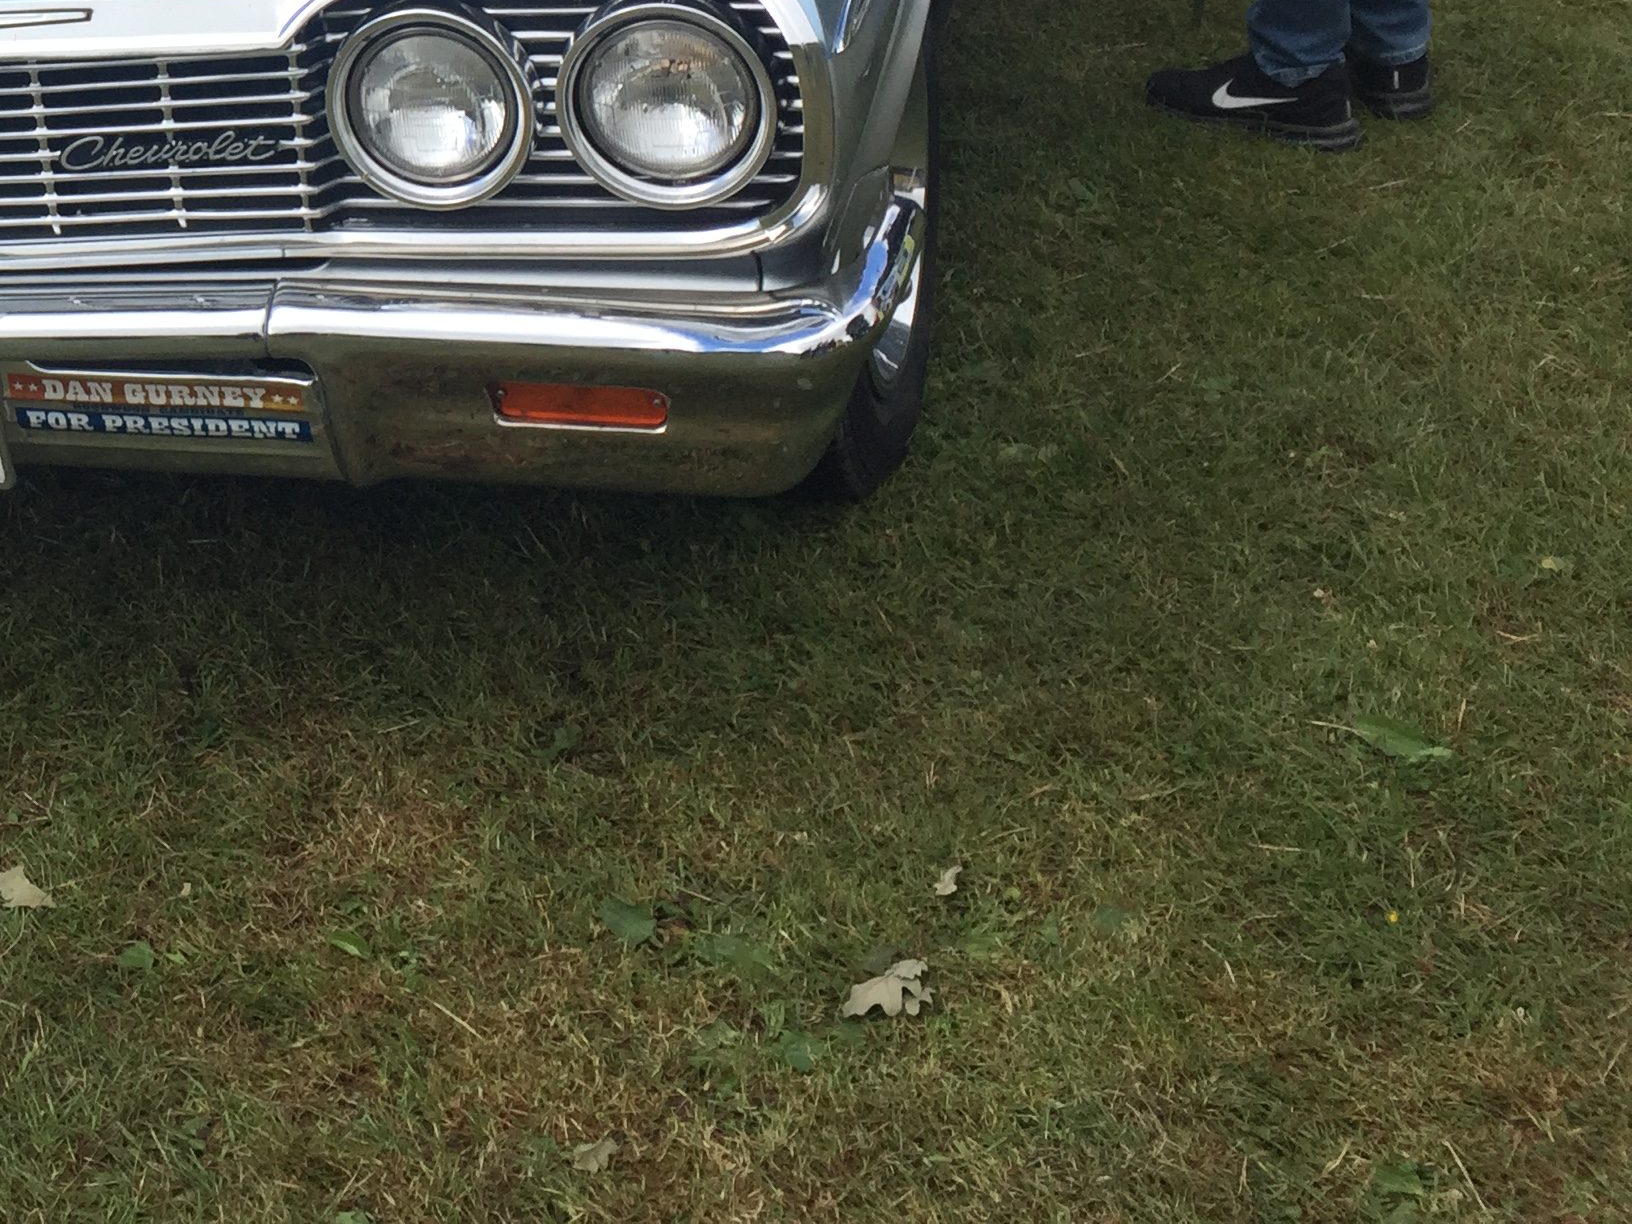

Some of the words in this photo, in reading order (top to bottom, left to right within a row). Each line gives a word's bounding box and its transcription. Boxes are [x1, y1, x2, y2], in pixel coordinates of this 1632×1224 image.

[61, 130, 276, 170] Chevrolet
[41, 378, 113, 404] DAN
[123, 381, 266, 408] GURNEY
[25, 409, 94, 432] FOR
[100, 413, 300, 440] PRESIDENT
